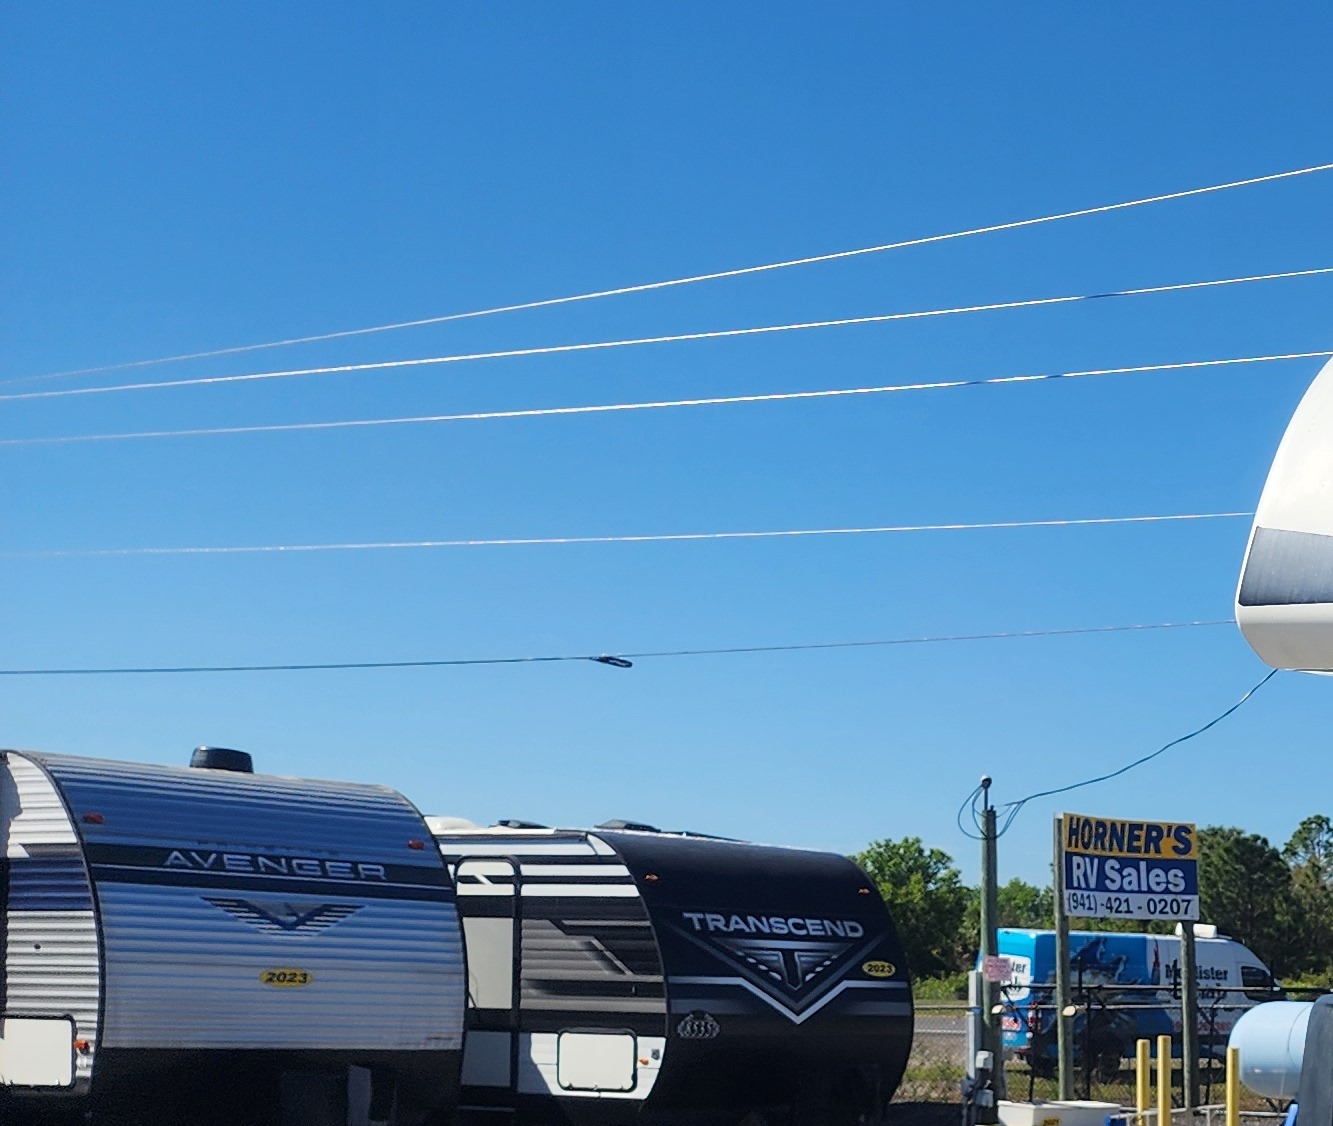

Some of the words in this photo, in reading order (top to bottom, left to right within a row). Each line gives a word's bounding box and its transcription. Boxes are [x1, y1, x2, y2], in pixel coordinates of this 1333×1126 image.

[1067, 816, 1192, 855] HORNER'S
[163, 850, 387, 880] AVENGER
[1072, 855, 1099, 889] RV
[1104, 858, 1186, 893] Sales
[682, 912, 864, 938] TRANSCEND
[265, 971, 308, 984] 2023
